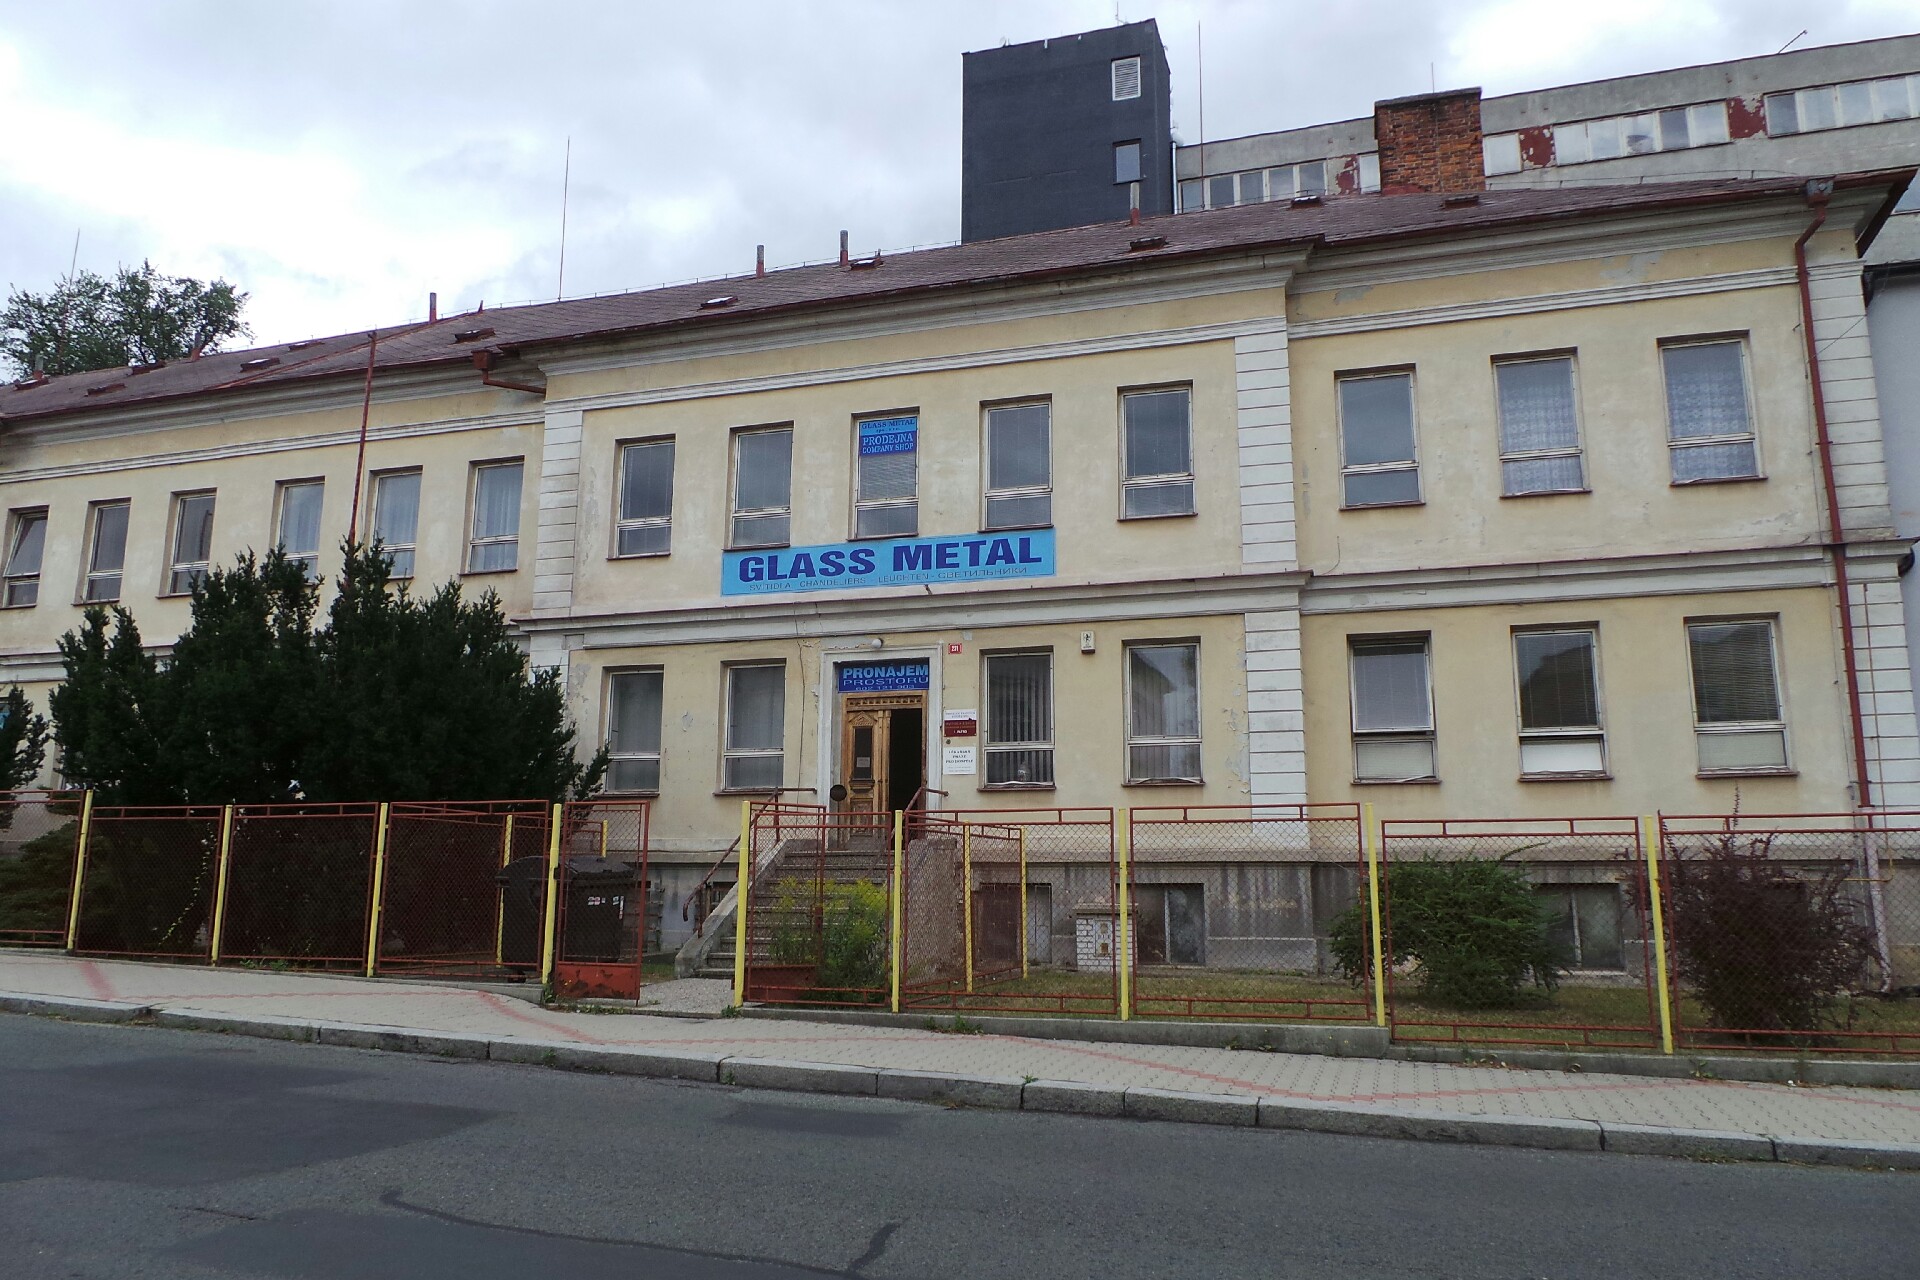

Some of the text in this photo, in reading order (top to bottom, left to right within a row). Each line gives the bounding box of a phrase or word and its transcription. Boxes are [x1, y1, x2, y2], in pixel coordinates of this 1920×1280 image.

[861, 419, 915, 429] GLASS METAL
[863, 433, 913, 445] PRODEJNA
[862, 442, 914, 454] COMPANY SHOP
[739, 537, 1043, 583] GLASS METAL
[937, 567, 1028, 579] СВЕТИЛЬНИКИ
[749, 582, 791, 591] SVTIDLA
[878, 573, 929, 583] LEUCHTEN
